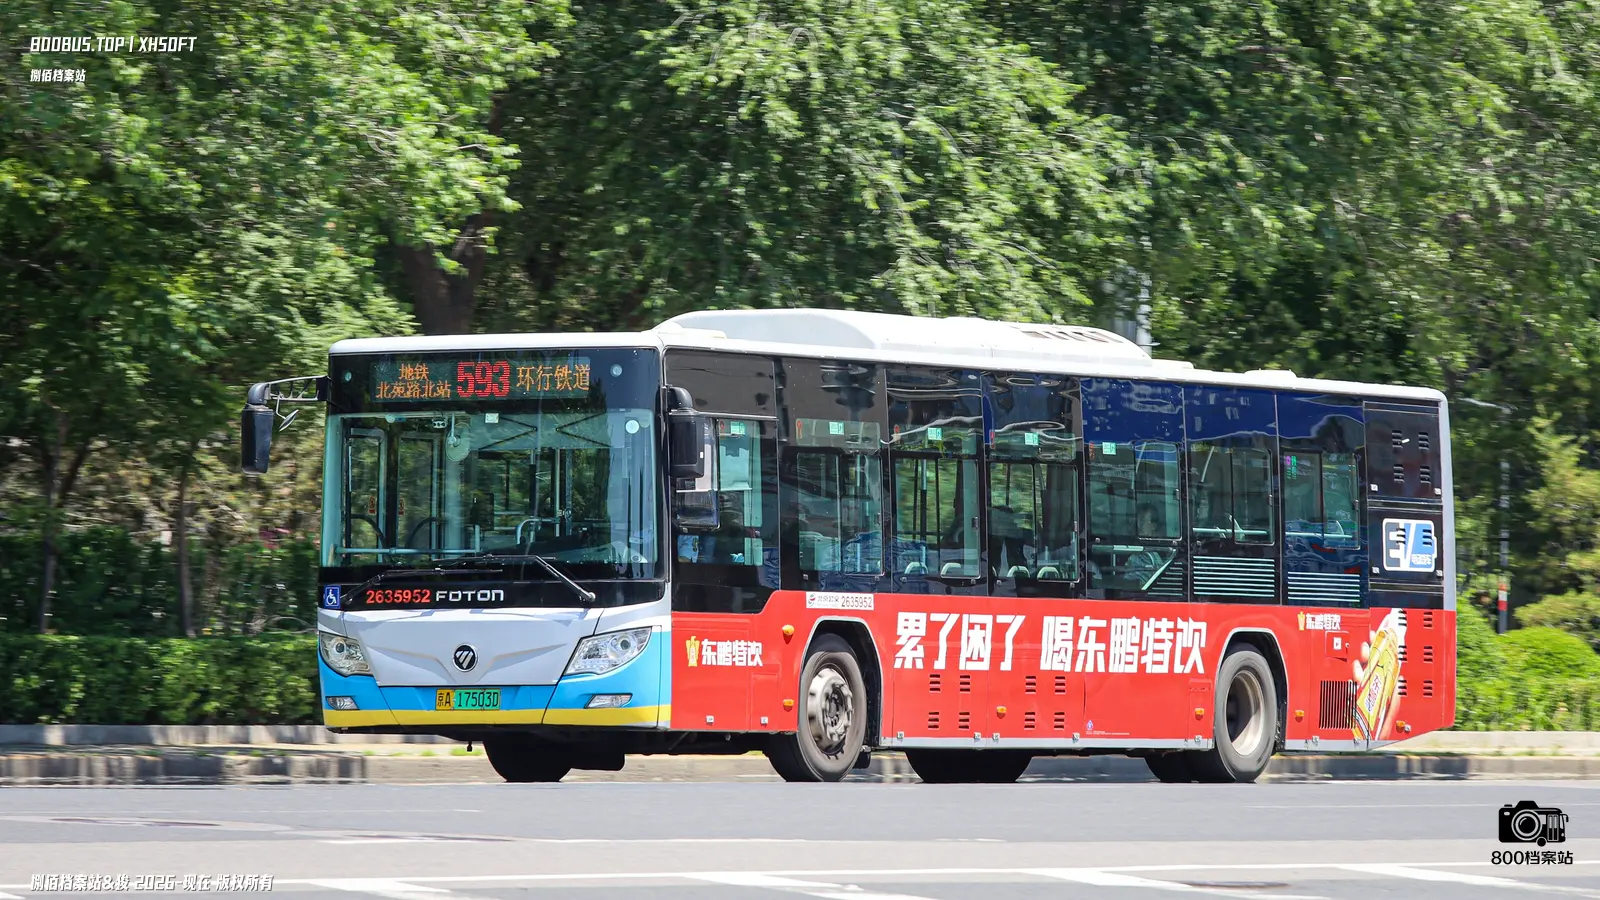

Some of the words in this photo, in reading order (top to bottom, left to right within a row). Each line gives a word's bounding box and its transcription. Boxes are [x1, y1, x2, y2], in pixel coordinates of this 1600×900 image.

[399, 363, 430, 381] 地铁
[457, 361, 511, 398] 593
[516, 364, 591, 392] 环行铁道
[375, 381, 452, 399] 北苑路北站
[366, 589, 431, 604] 2635952
[436, 589, 504, 602] FOTON
[841, 595, 873, 608] 2635952
[893, 611, 1026, 671] 累了困了
[1040, 615, 1207, 674] 喝东鹏特饮
[701, 638, 763, 667] 东鹏特饮
[457, 691, 500, 708] 17503D
